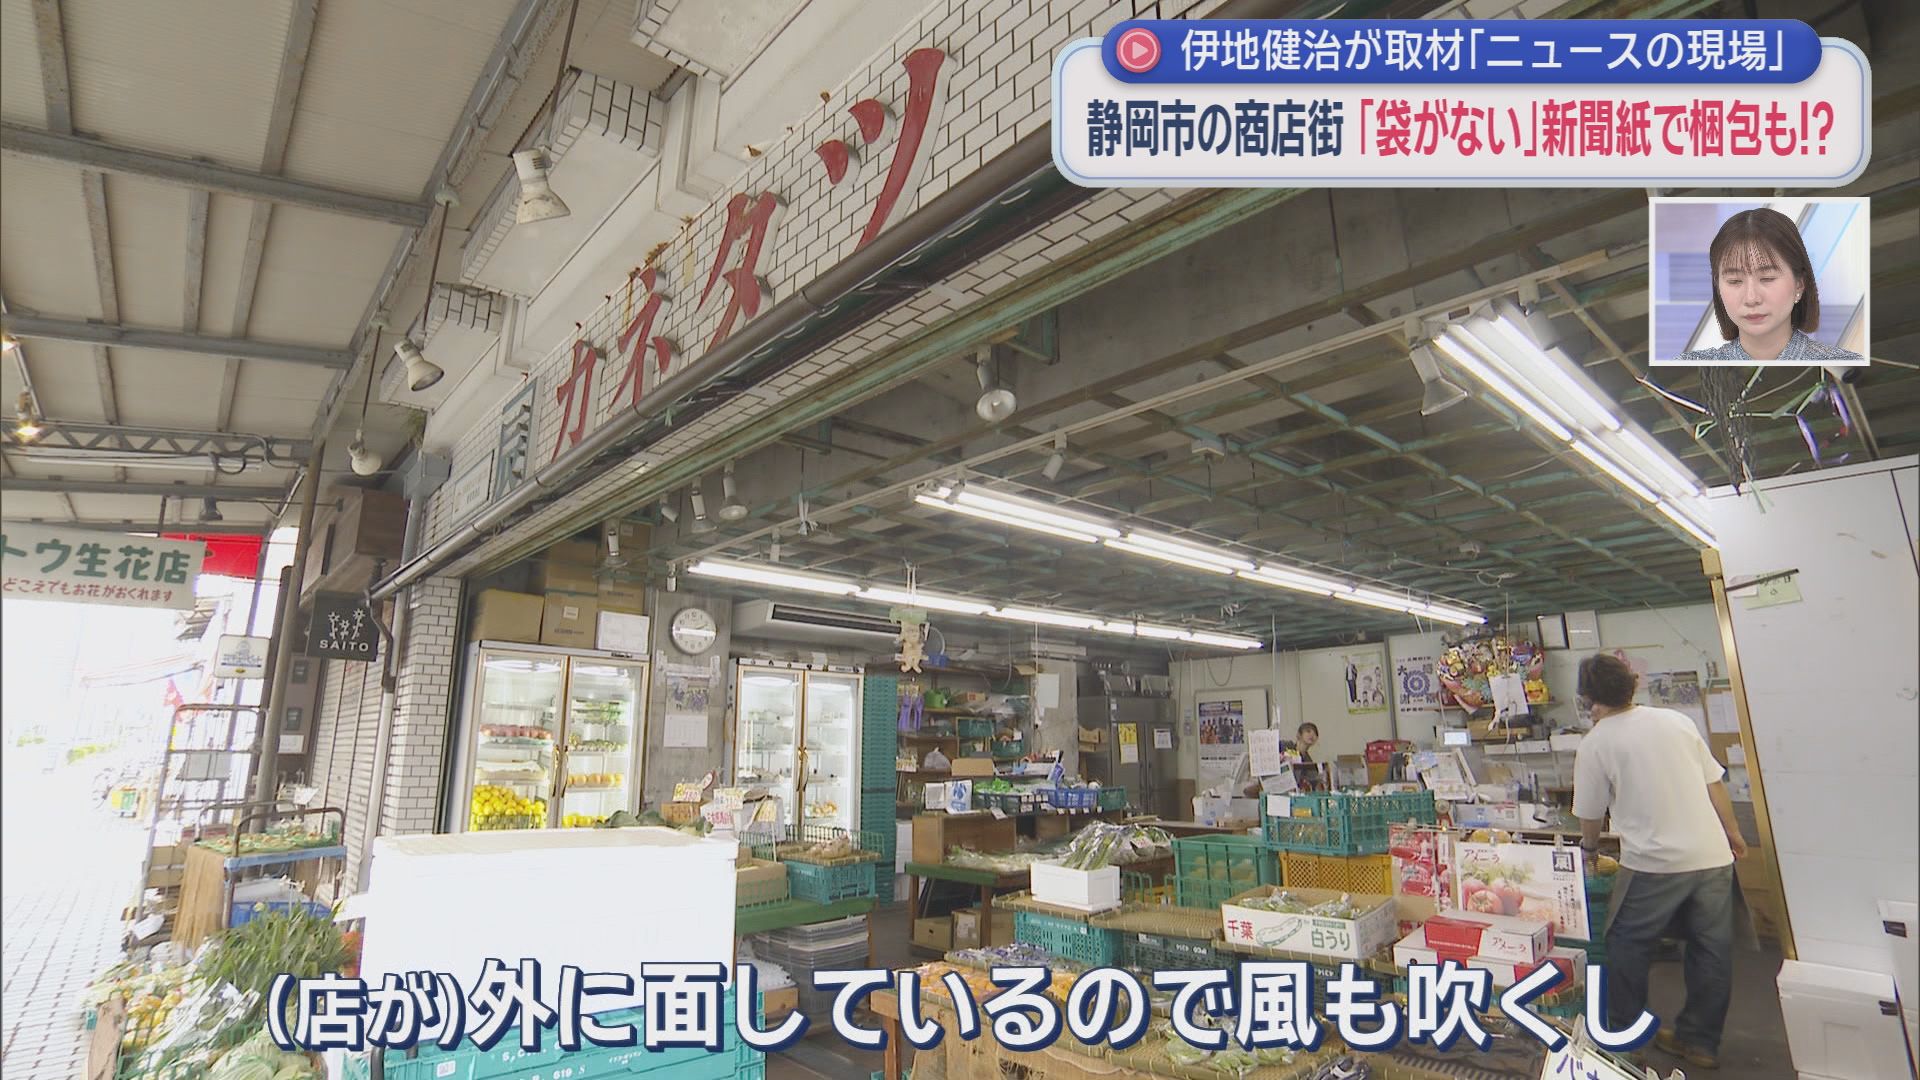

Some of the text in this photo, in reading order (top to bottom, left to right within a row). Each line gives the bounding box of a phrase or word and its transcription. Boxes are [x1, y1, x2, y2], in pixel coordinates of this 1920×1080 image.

[551, 47, 950, 463] カネタツ
[1, 534, 191, 584] トウ生花店
[3, 577, 173, 601] どこえでもお花がおくれます
[319, 639, 369, 652] SAITO
[1227, 919, 1254, 940] 千葉
[1311, 928, 1351, 951] 白うり
